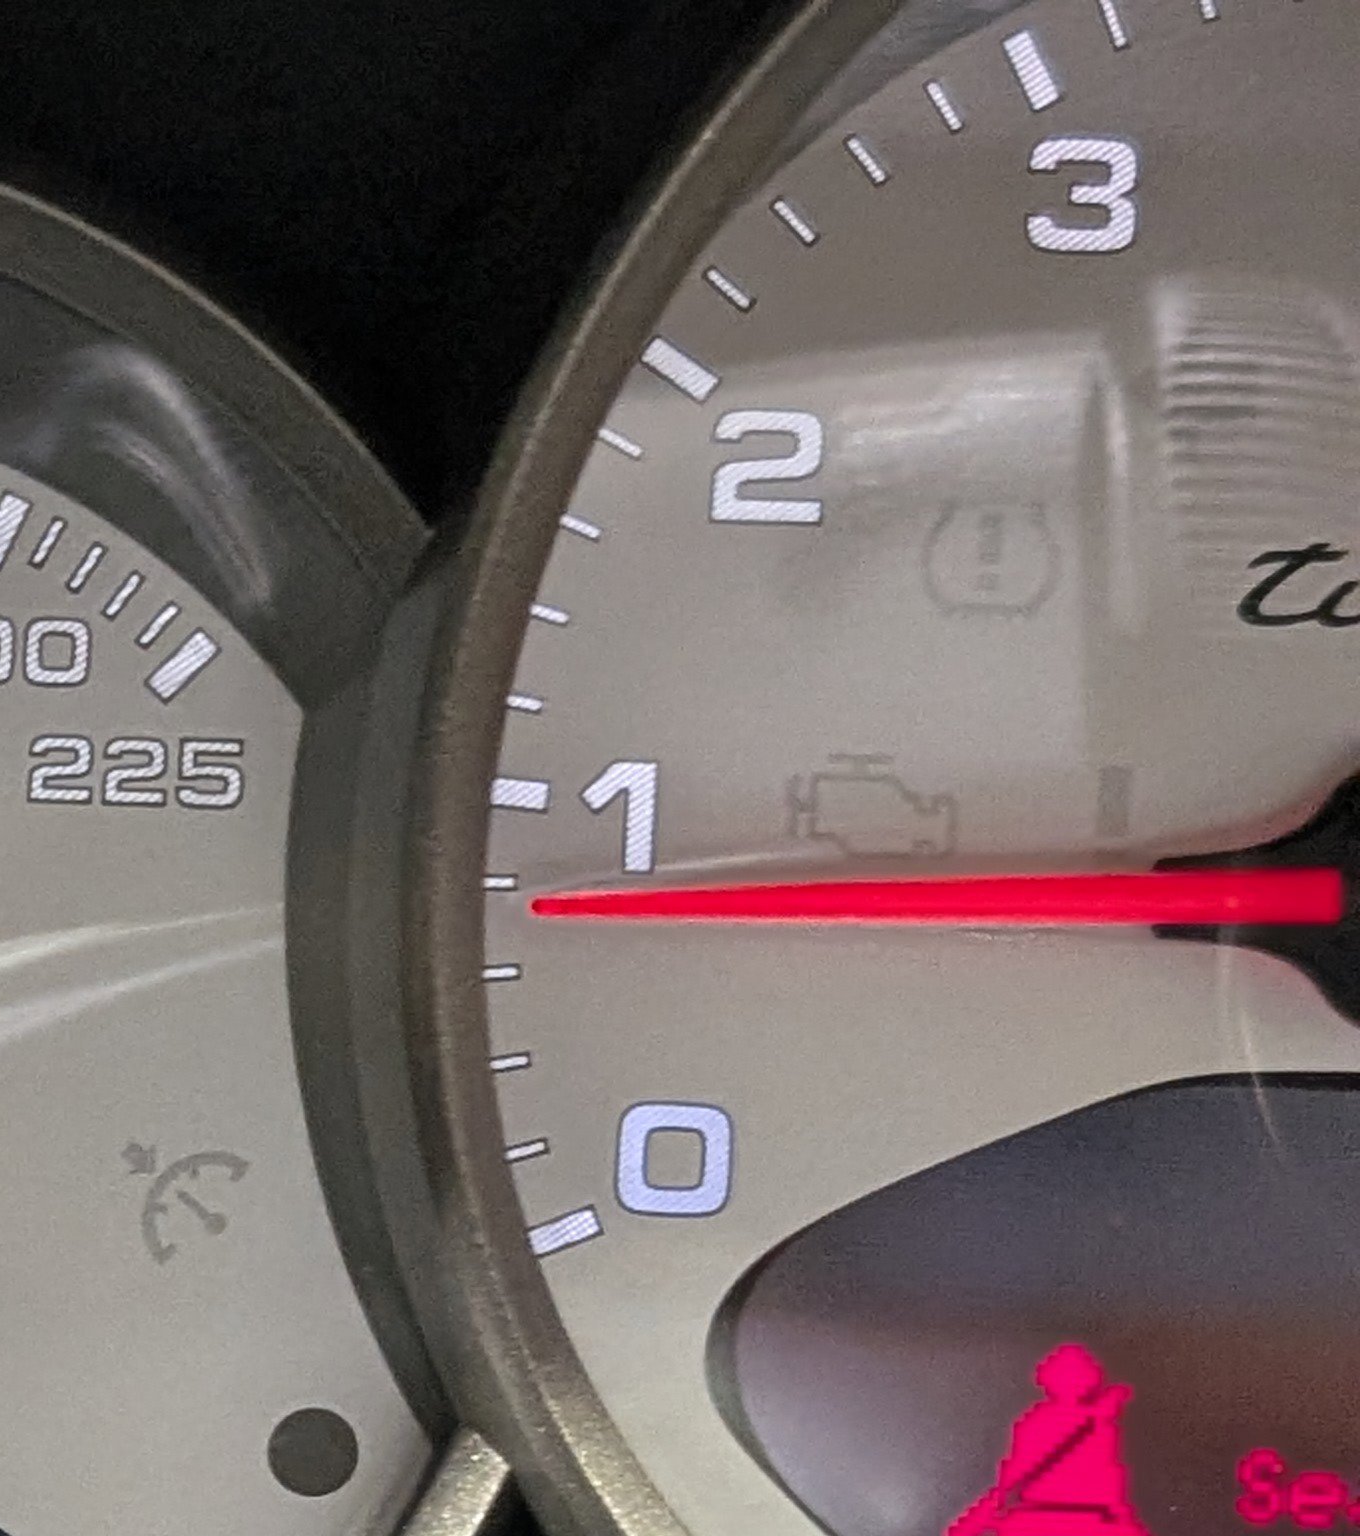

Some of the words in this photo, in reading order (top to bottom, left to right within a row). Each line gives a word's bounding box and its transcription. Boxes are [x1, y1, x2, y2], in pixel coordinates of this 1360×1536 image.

[1026, 137, 1138, 252] 3
[709, 409, 824, 525] 2
[26, 734, 246, 810] 225
[581, 760, 659, 874] 1
[615, 1100, 734, 1218] 0
[1237, 1449, 1360, 1531] Se
